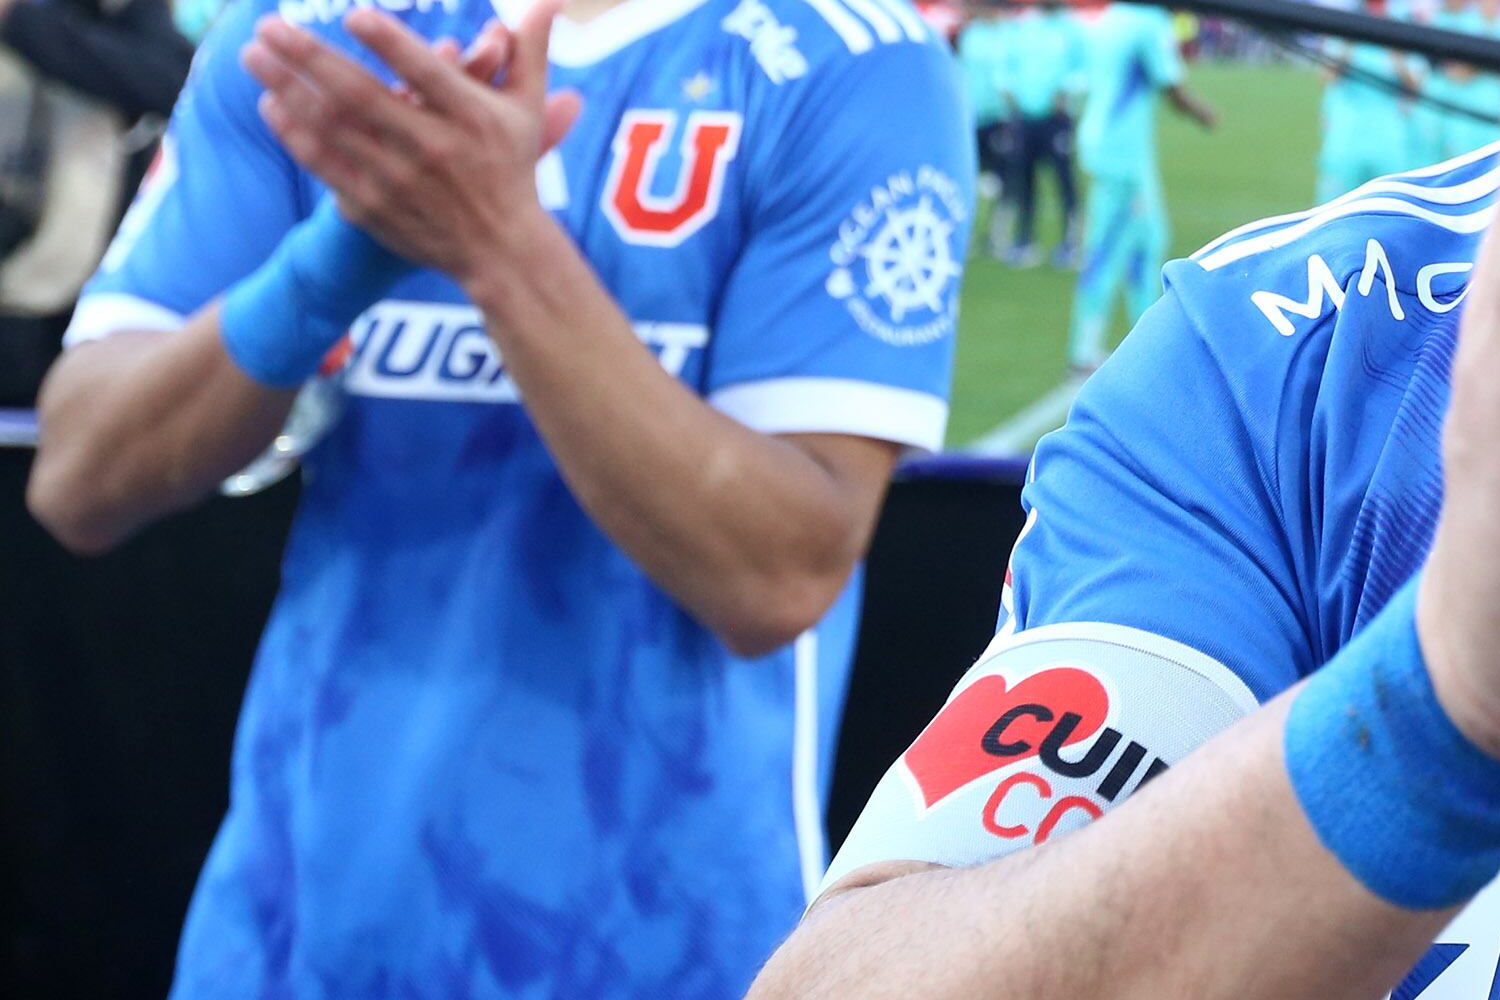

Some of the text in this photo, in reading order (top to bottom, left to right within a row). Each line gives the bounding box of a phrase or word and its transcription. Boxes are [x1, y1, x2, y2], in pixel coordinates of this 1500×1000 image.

[600, 108, 744, 249] U
[1251, 238, 1475, 336] MAC
[981, 703, 1169, 803] CUI
